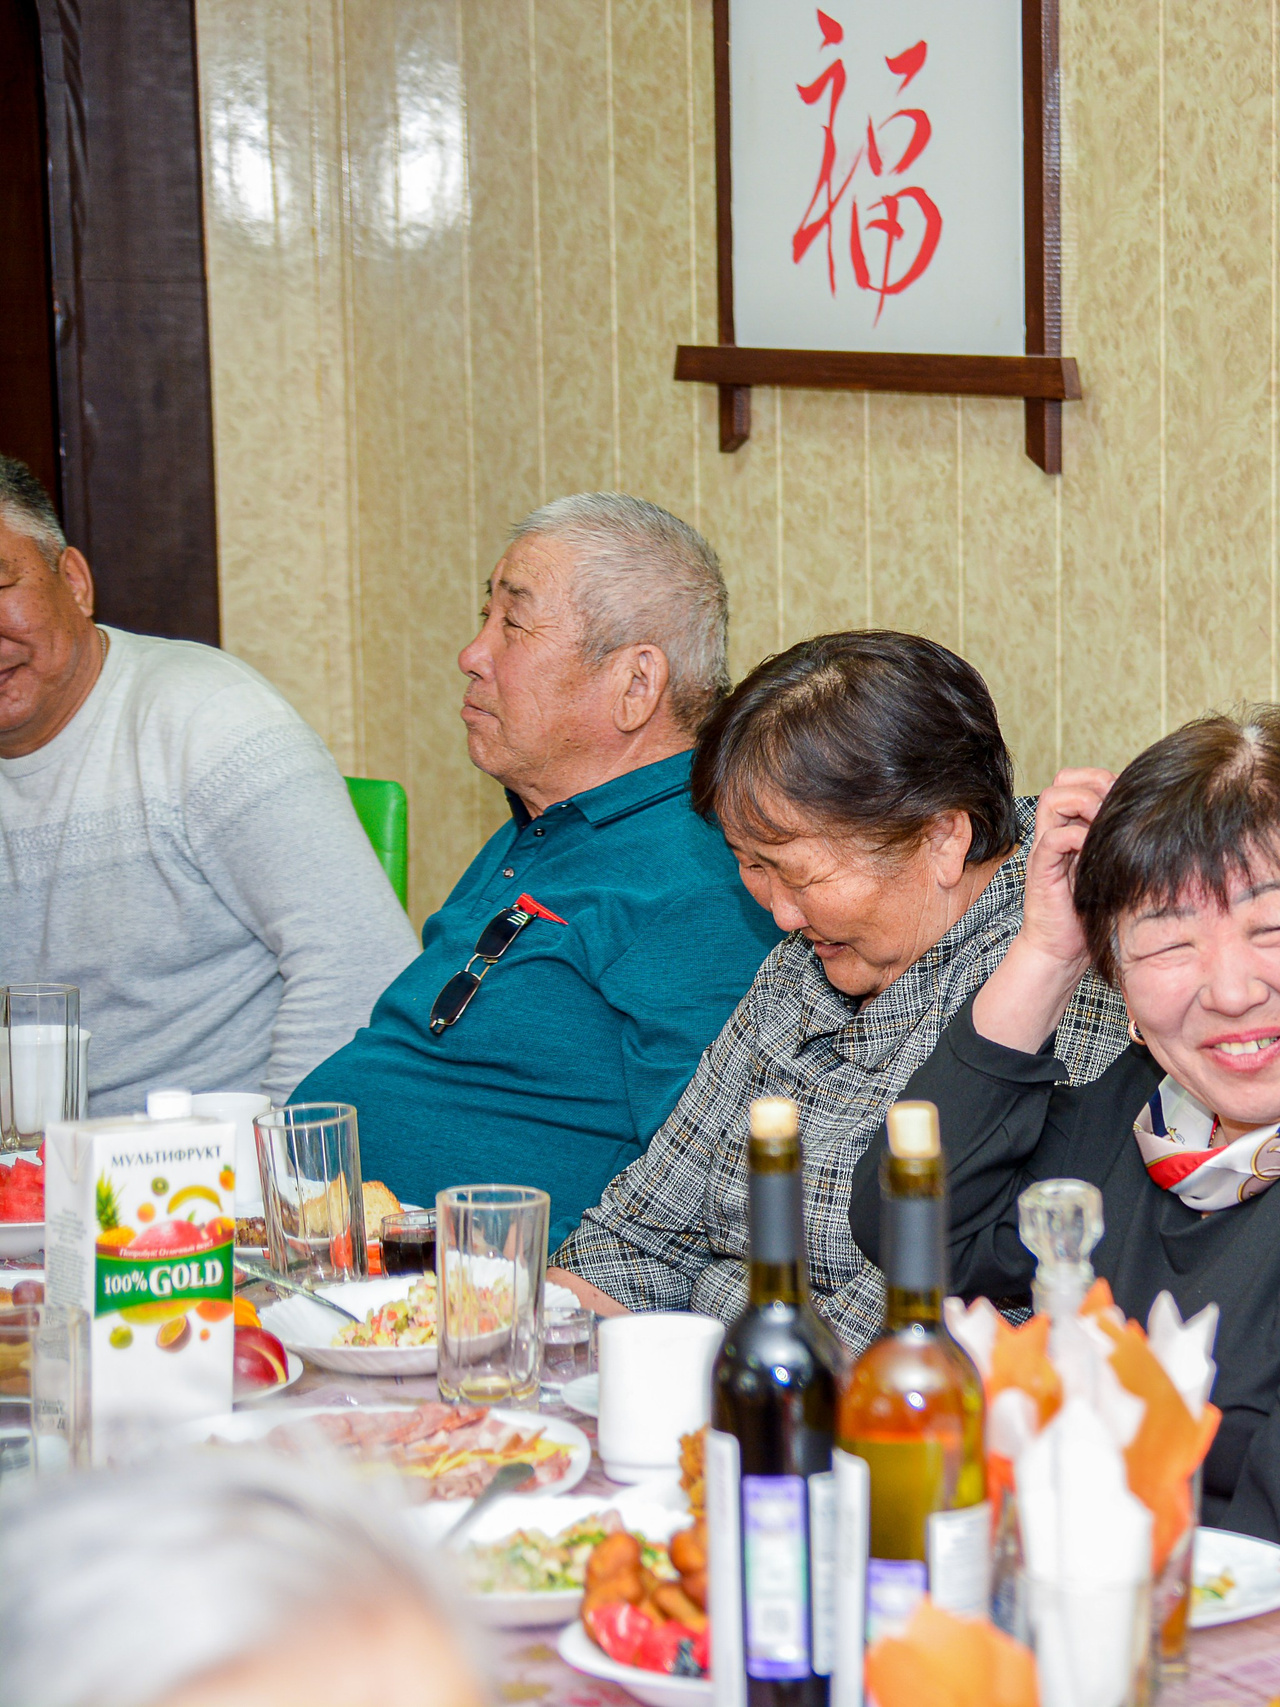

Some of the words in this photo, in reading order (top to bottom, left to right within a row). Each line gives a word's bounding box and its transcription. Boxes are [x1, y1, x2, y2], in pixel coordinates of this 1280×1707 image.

[791, 8, 943, 328] 福
[111, 1145, 221, 1167] МУЛЬТИФРУКТ
[104, 1270, 148, 1295] 100%
[149, 1259, 224, 1296] GOLD
